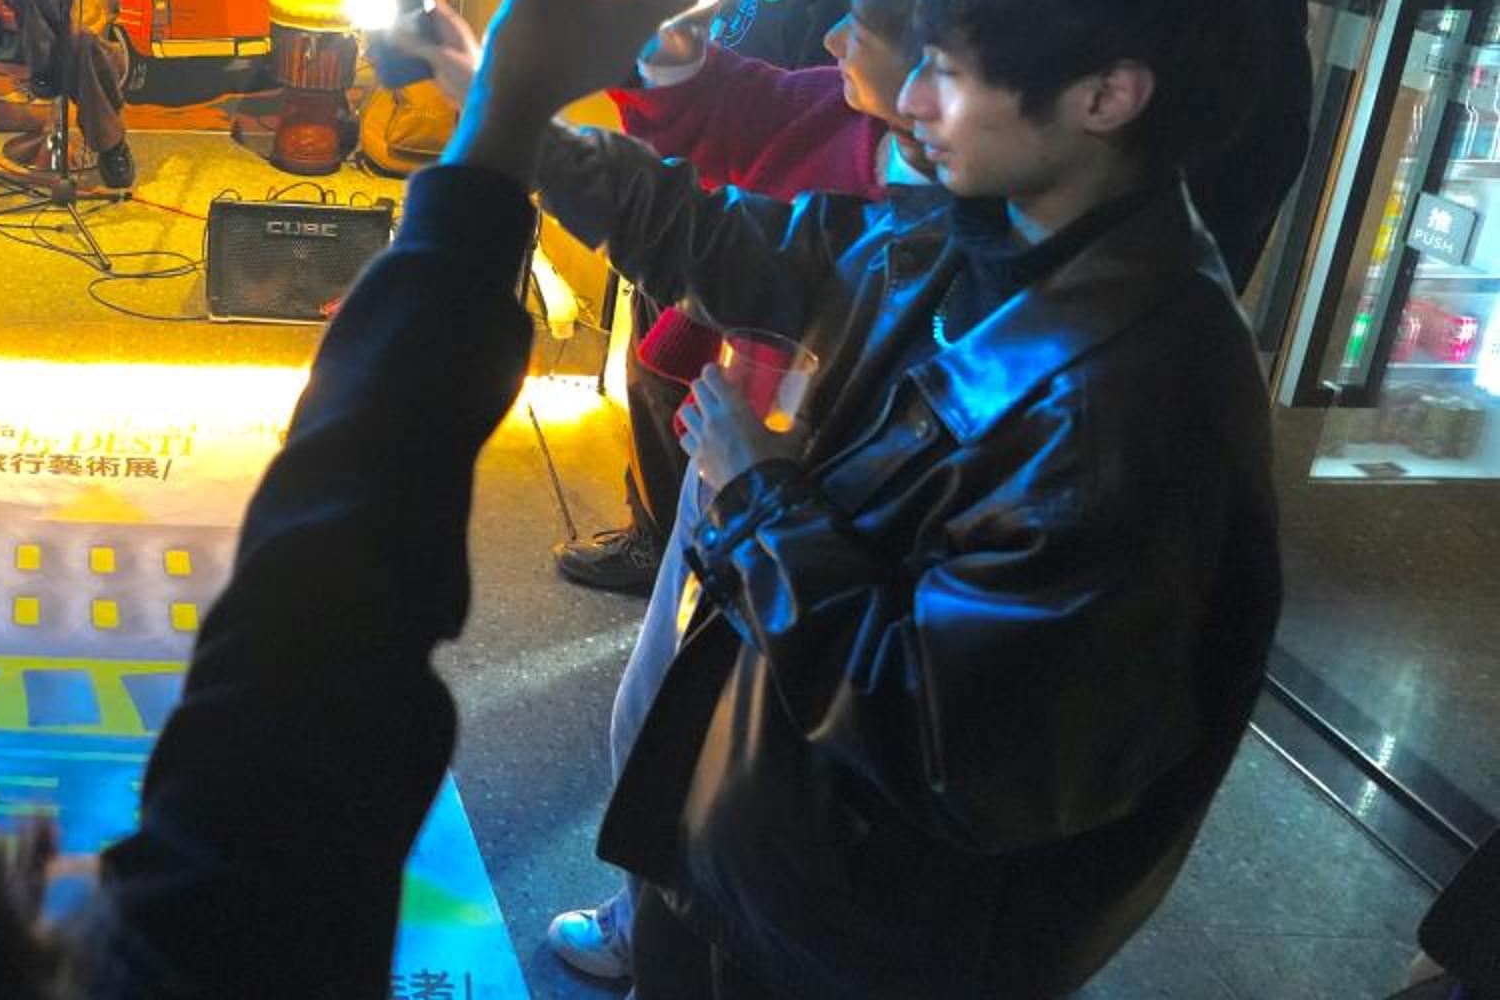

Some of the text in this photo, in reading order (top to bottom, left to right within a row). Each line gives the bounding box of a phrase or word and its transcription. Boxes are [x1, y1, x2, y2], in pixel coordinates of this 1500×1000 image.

[265, 220, 338, 237] CUBE
[1427, 206, 1452, 233] 推
[1414, 228, 1454, 255] PUSH
